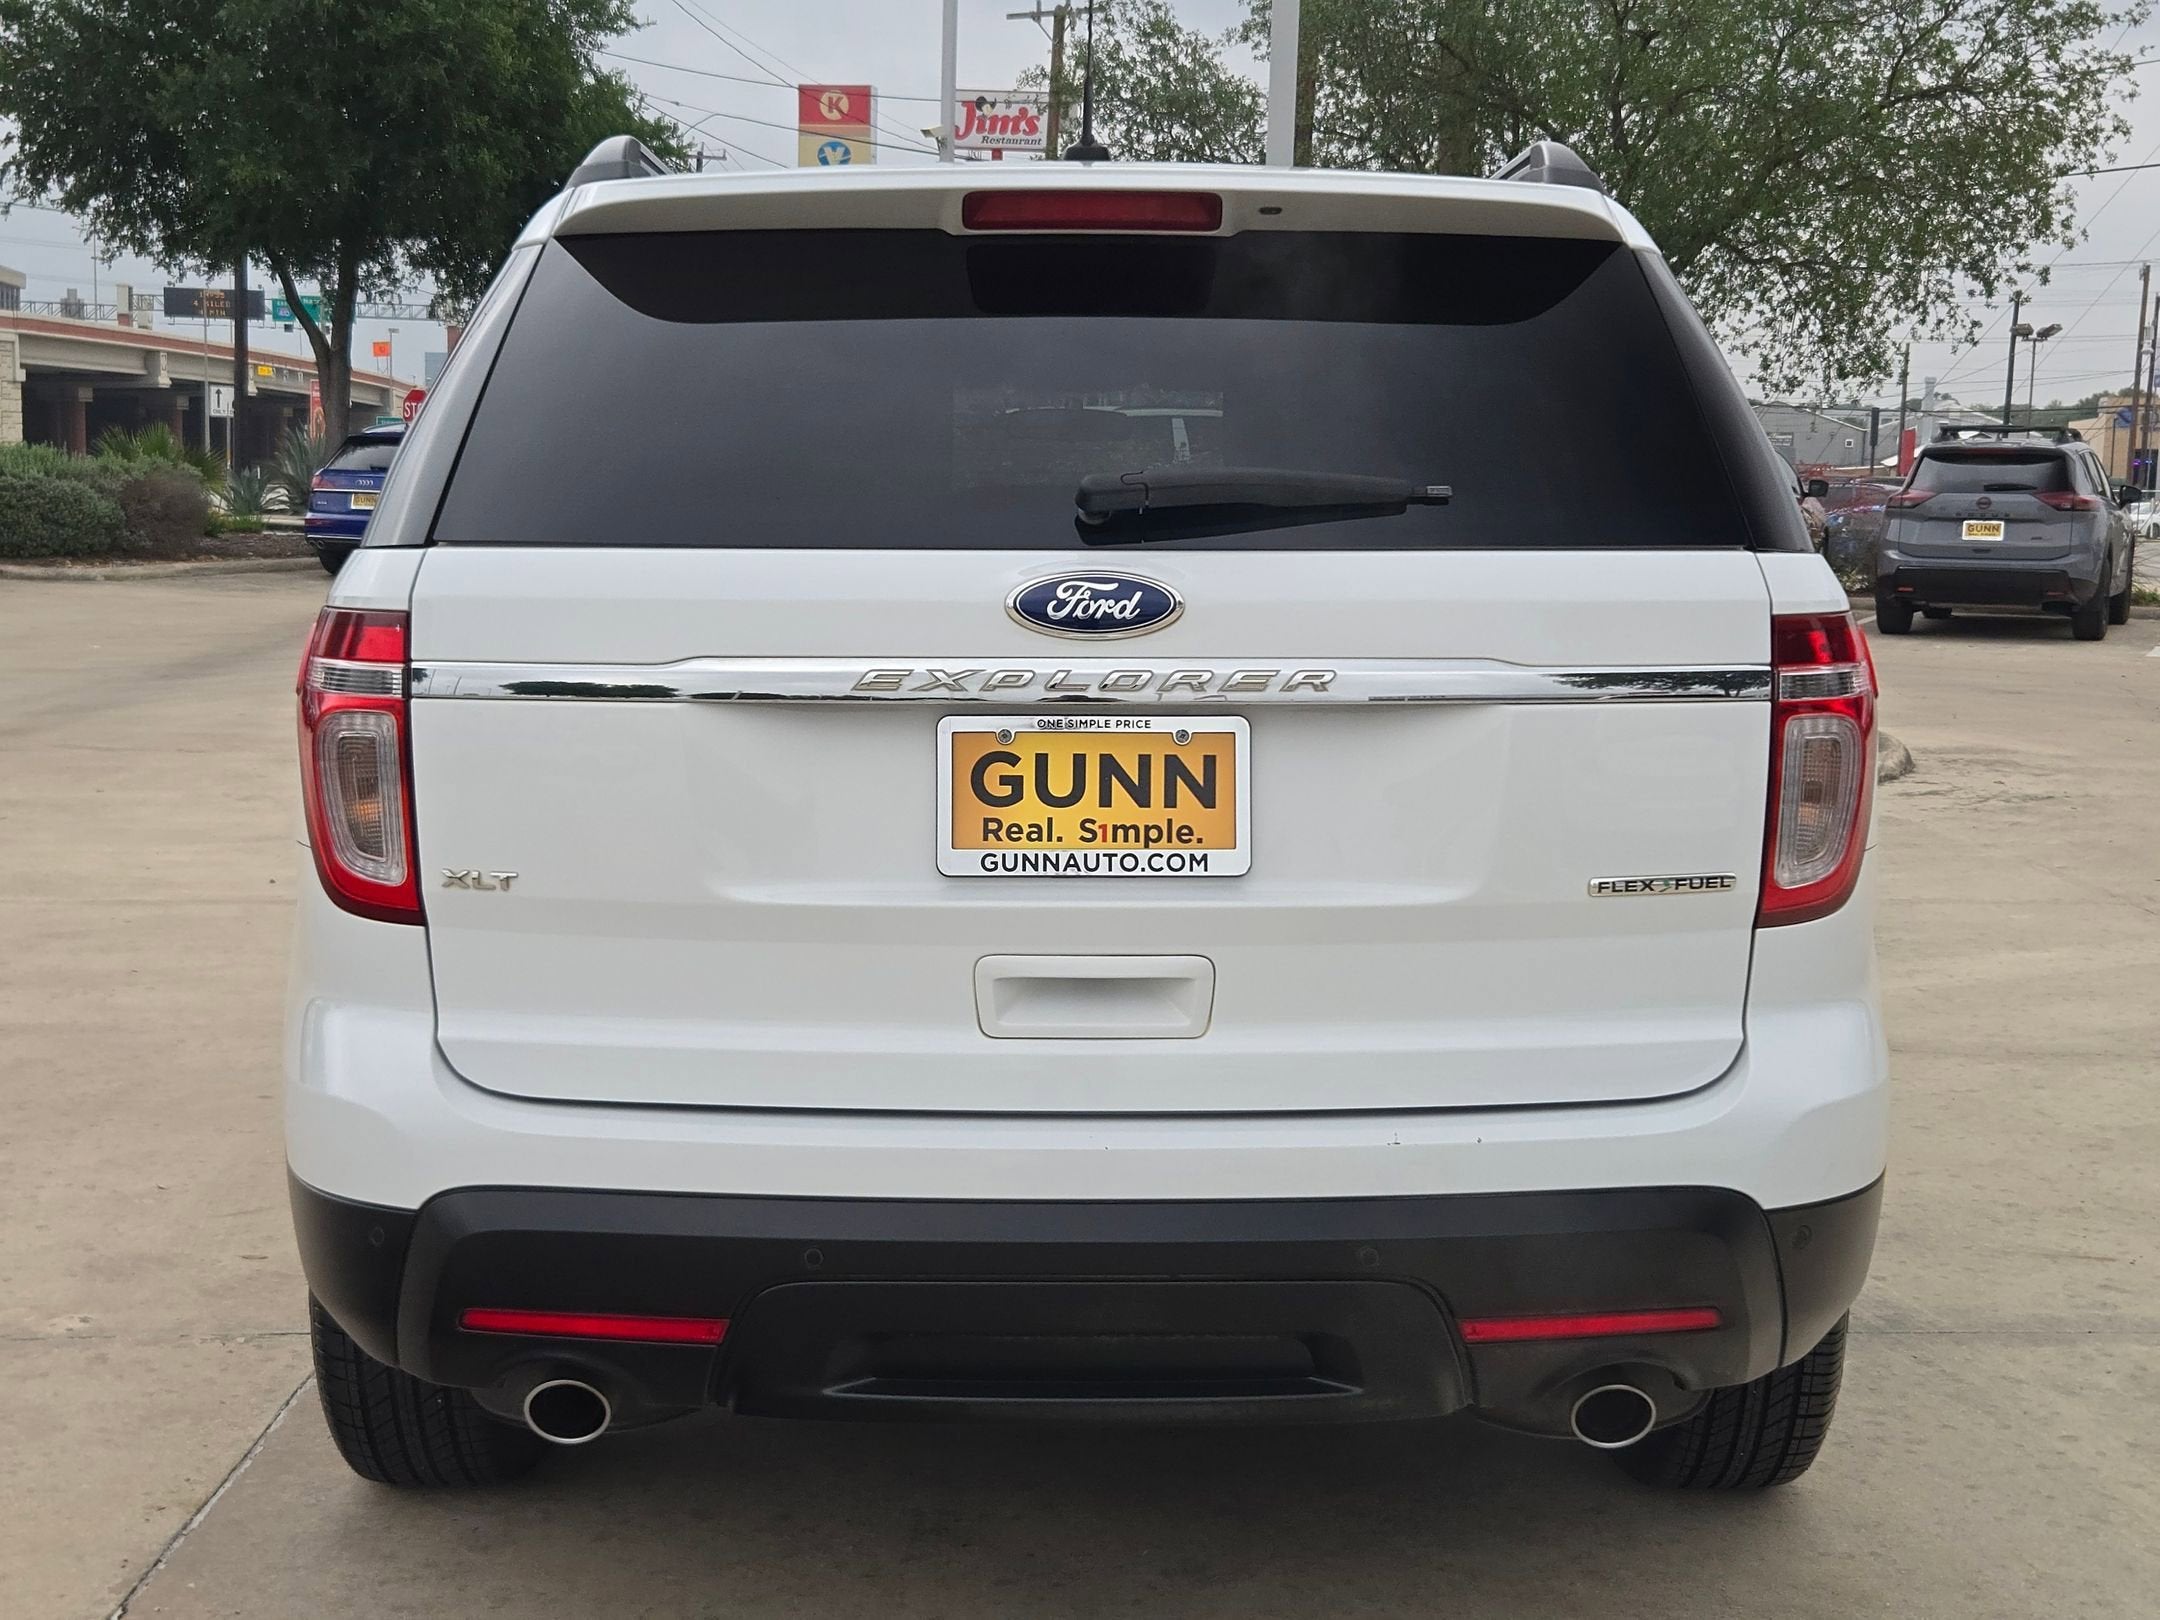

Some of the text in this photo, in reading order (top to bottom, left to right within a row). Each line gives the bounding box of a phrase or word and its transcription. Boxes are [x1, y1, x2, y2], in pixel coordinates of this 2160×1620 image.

[954, 100, 1041, 141] Jim's
[981, 135, 1042, 146] Restaurant
[1967, 524, 2000, 533] GUNN
[1046, 580, 1143, 622] Ford
[850, 668, 1338, 693] EXPLORER
[1037, 718, 1152, 730] ONE SIMPLE PRICE
[970, 751, 1217, 809] GUNN
[982, 817, 1063, 843] Real.
[980, 852, 1209, 873] GUNNAUTO.COM
[440, 868, 519, 892] XLT
[1597, 876, 1732, 894] FLEX FUEL
